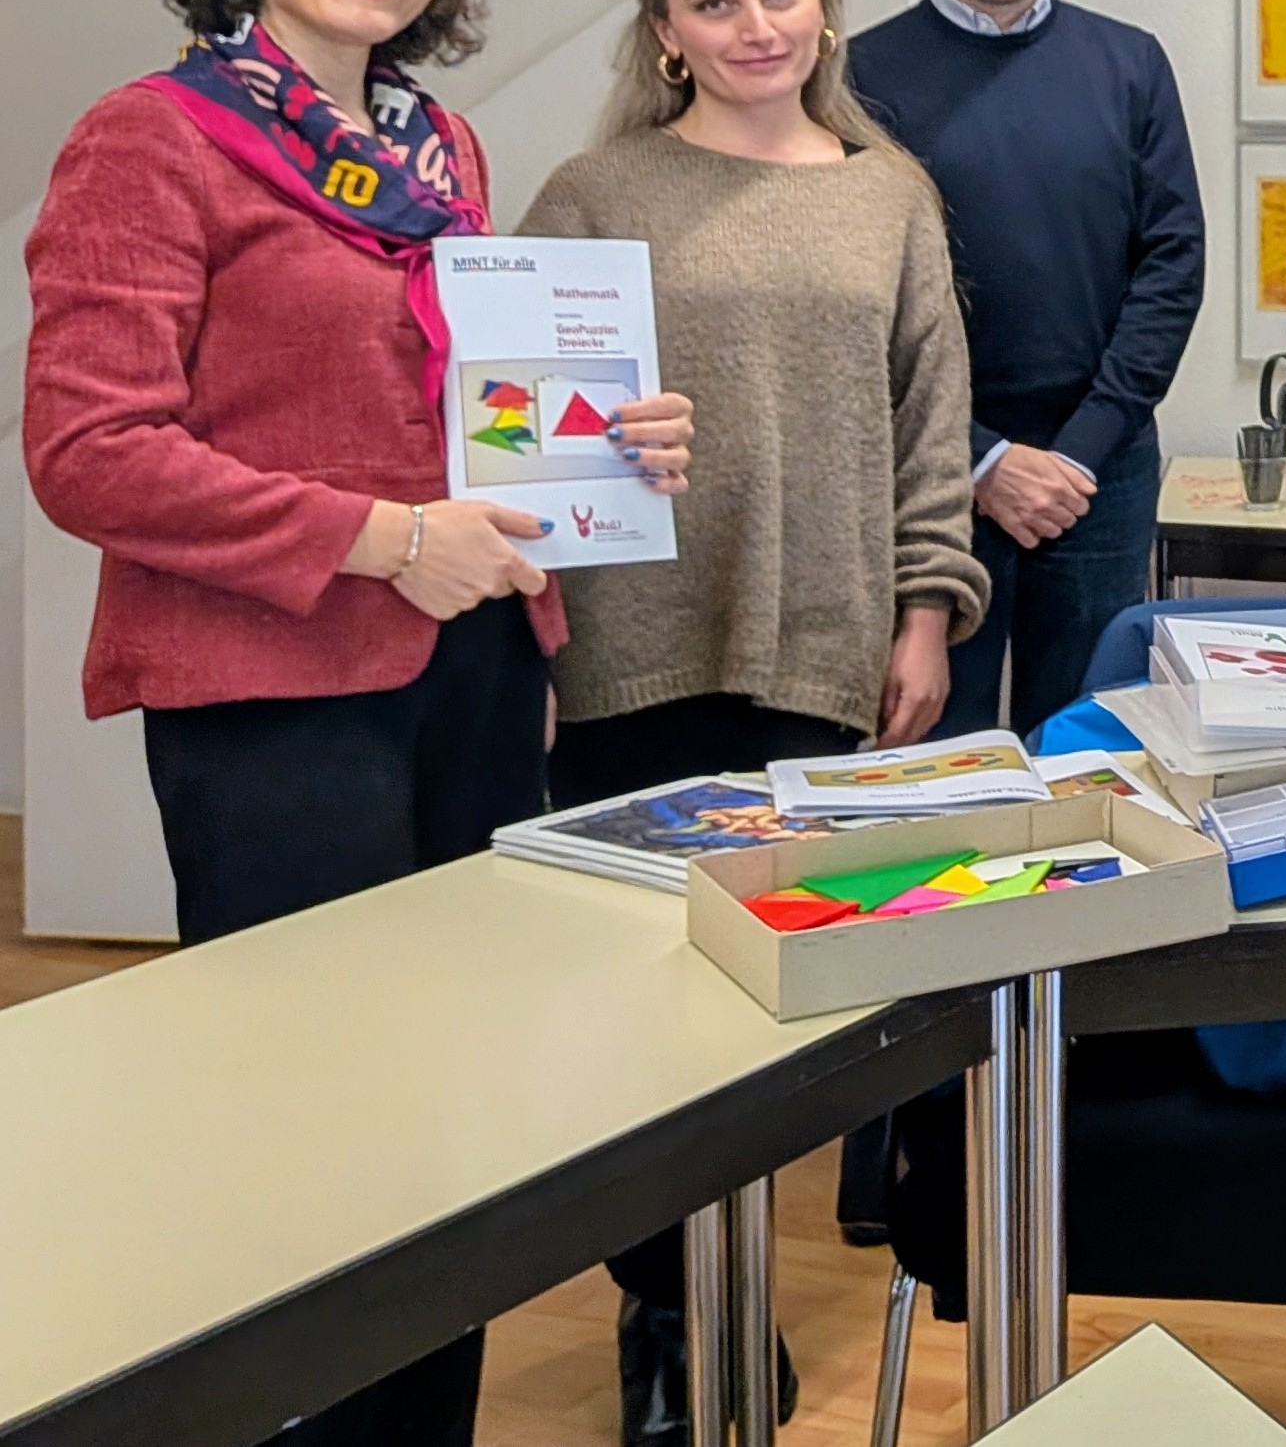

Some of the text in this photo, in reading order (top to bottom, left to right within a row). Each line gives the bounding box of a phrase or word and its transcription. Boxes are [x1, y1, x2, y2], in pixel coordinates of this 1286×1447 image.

[452, 255, 537, 271] MINT für alle
[552, 286, 620, 300] Mathematik
